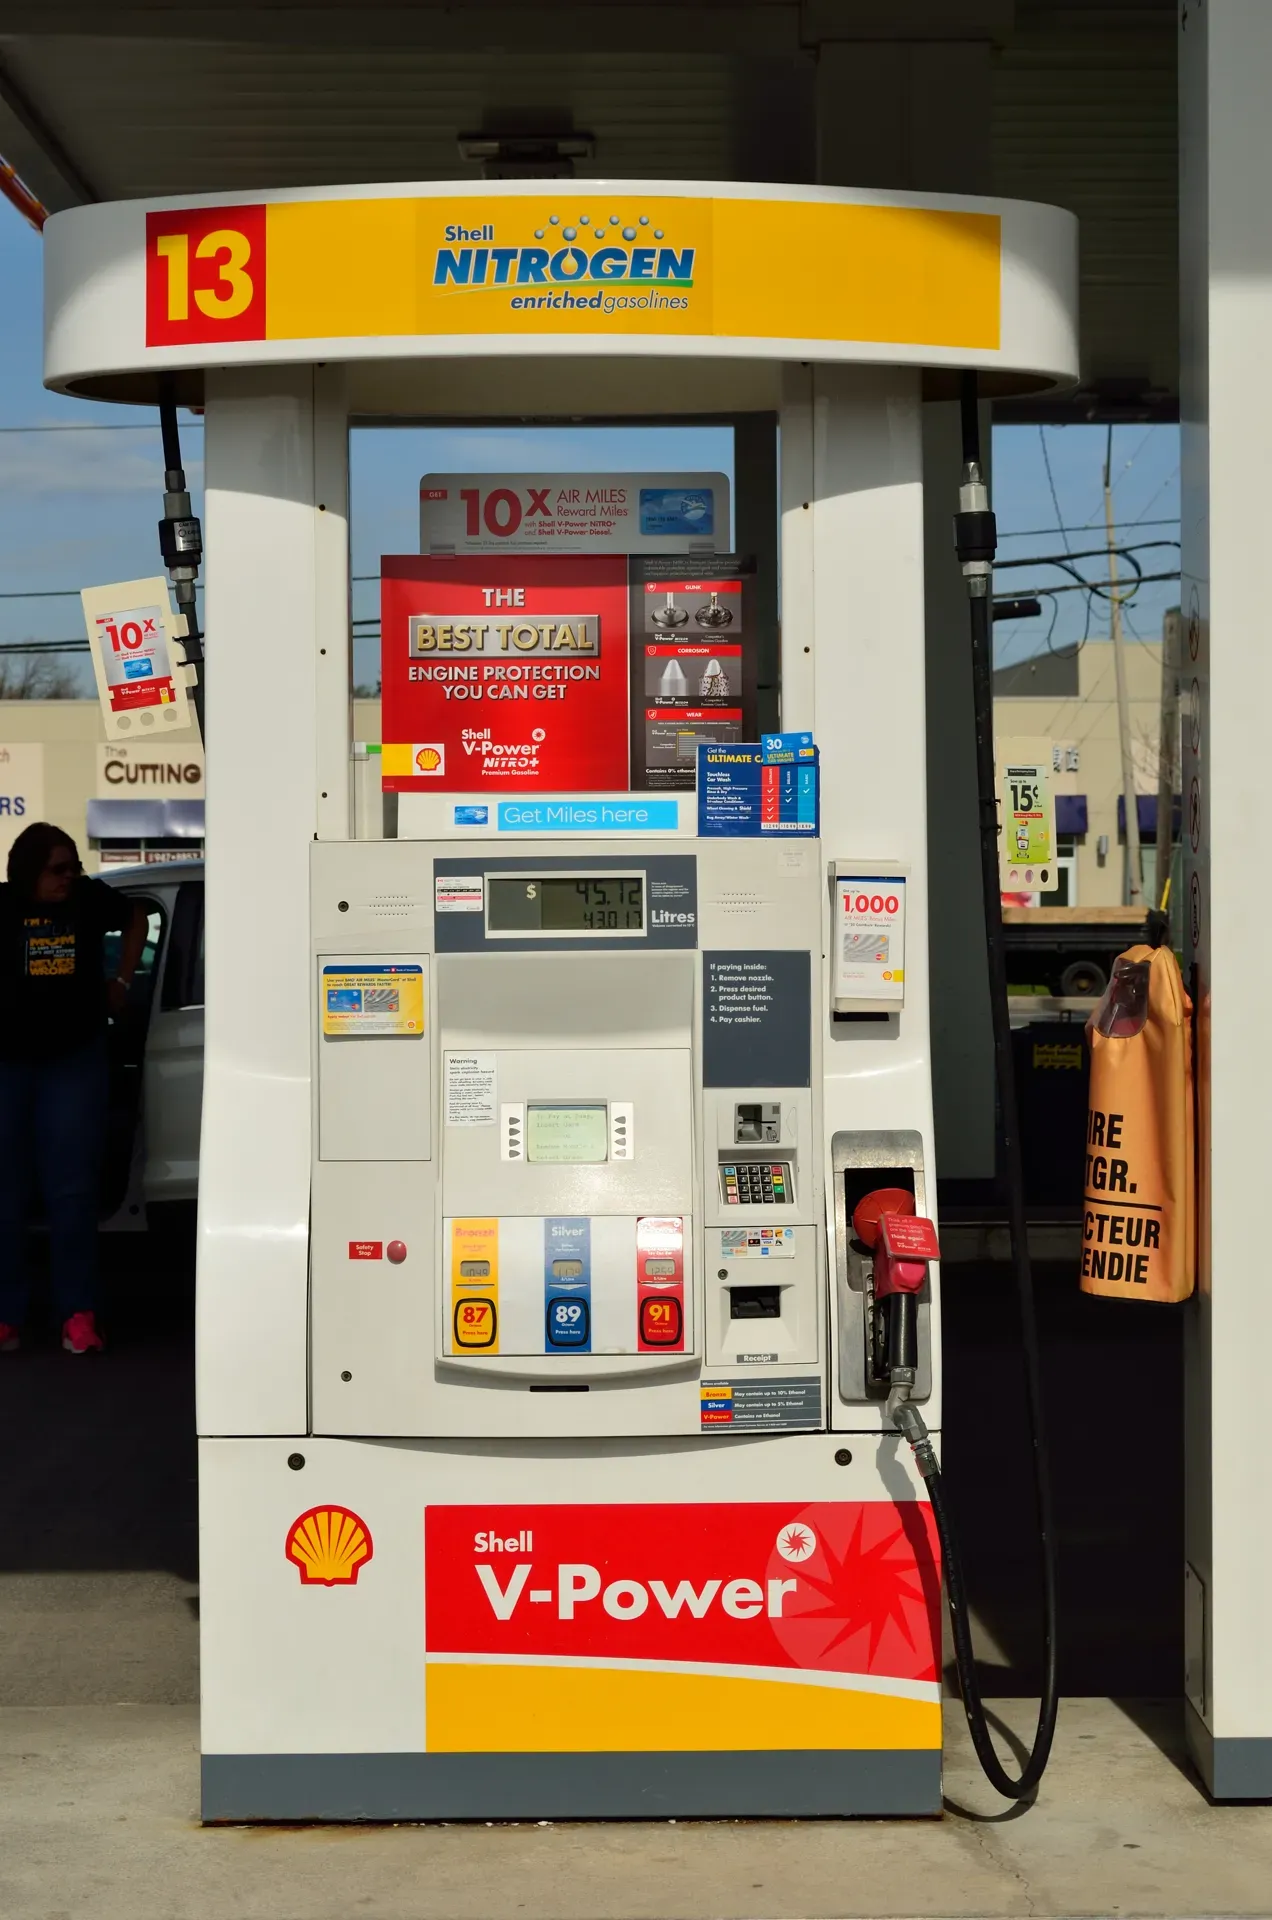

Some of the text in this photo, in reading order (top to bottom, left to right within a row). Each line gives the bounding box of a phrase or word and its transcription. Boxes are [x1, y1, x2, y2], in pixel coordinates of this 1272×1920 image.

[444, 224, 494, 242] Shell
[432, 247, 695, 286] NITROGEN
[156, 230, 254, 321] 13
[556, 489, 580, 504] AIR
[557, 504, 629, 517] Reward Miles
[538, 520, 556, 528] Shell
[557, 520, 587, 528] V-Power
[481, 588, 526, 608] THE
[416, 623, 594, 651] BEST TOTAL
[408, 665, 601, 681] ENGINE PROTECTION
[442, 684, 567, 700] YOU CAN GET
[461, 728, 491, 740] Shell
[105, 746, 128, 758] The
[462, 741, 540, 756] V-Power
[767, 738, 782, 750] 30
[707, 755, 752, 763] ULTIMATE
[504, 807, 649, 824] Get Miles here
[526, 883, 537, 900] $
[576, 880, 641, 905] 45.12
[843, 894, 899, 914] 1,000
[651, 909, 696, 923] Litres
[29, 934, 76, 946] MOM
[717, 963, 742, 971] paying
[718, 994, 746, 1002] product
[718, 1016, 733, 1024] Pay
[551, 1226, 584, 1237] Silver
[1084, 1210, 1161, 1250] CTEUR
[1081, 1247, 1150, 1284] ENDIE
[462, 1307, 489, 1324] 87
[555, 1306, 581, 1323] 89
[649, 1304, 670, 1321] 91
[743, 1355, 772, 1363] Receipt
[474, 1530, 533, 1553] Shell
[474, 1563, 797, 1621] V-Power
